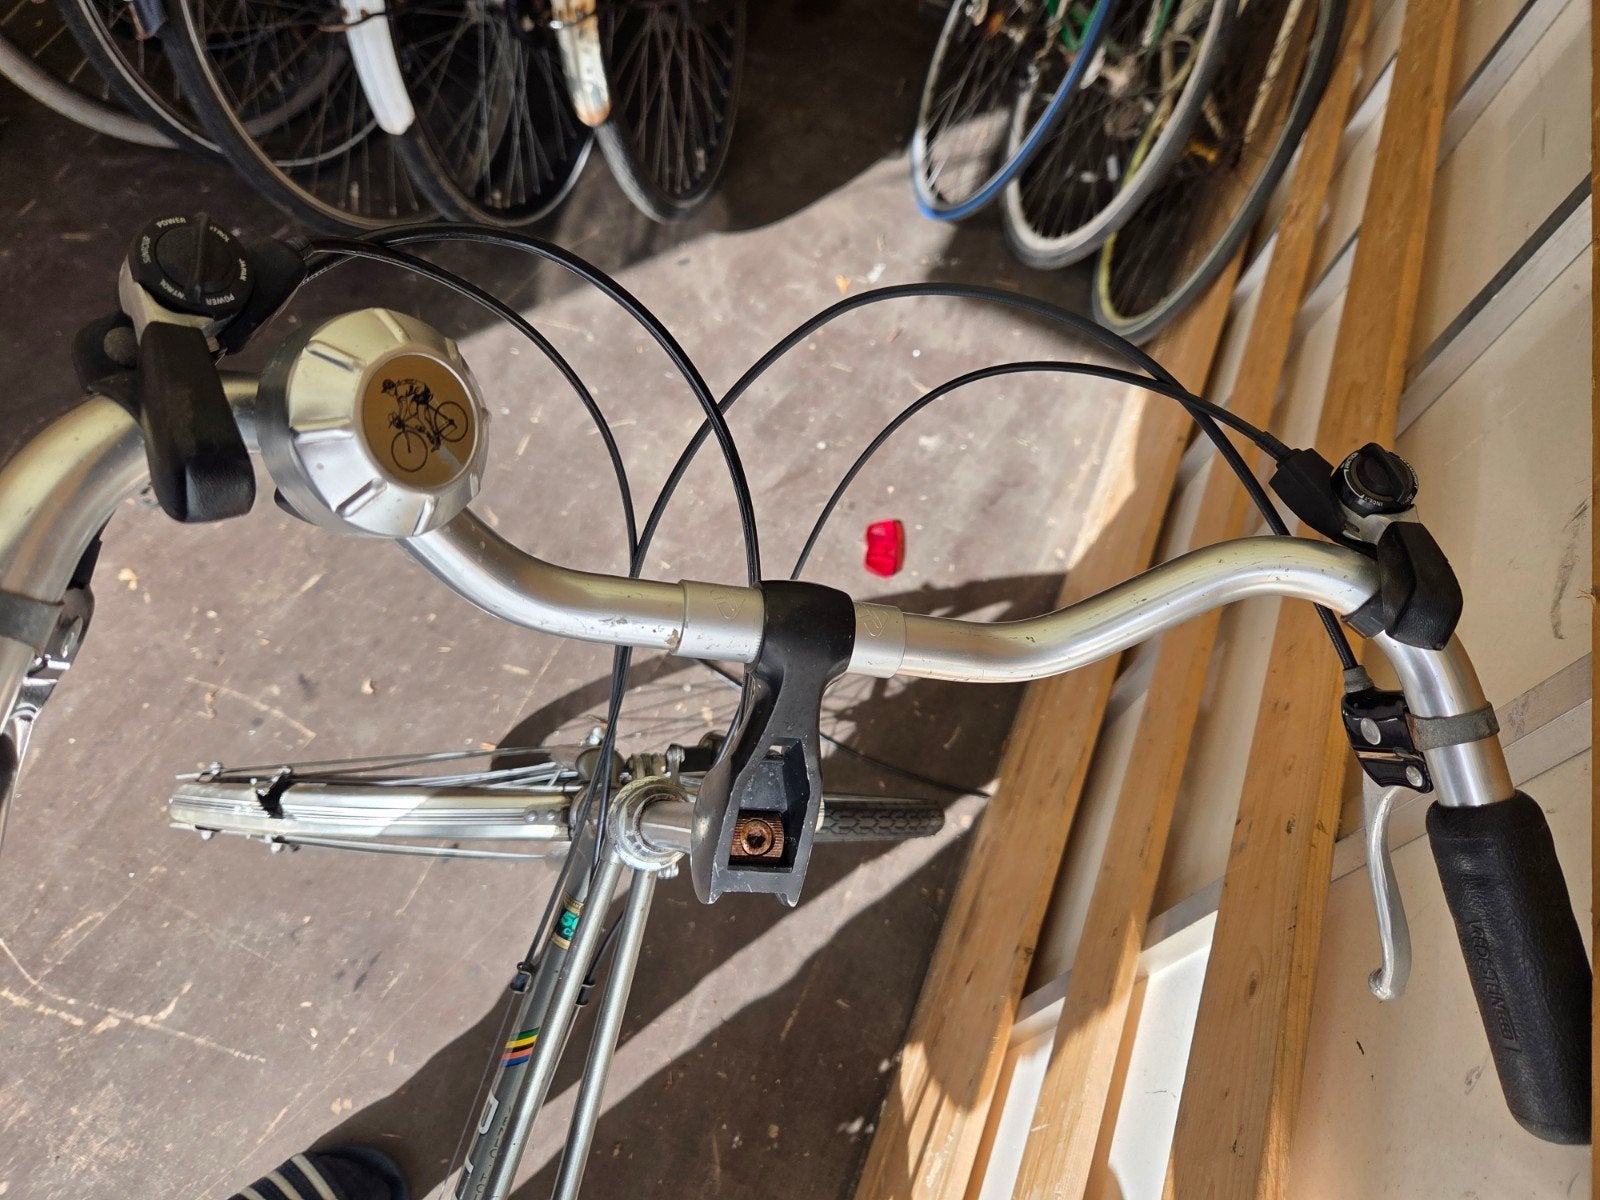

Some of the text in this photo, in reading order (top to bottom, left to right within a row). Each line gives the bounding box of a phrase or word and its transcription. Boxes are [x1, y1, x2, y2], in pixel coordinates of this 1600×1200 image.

[156, 217, 187, 229] POWER
[160, 278, 235, 306] POWER NTROL
[1466, 920, 1507, 1011] VREDESTEIN
